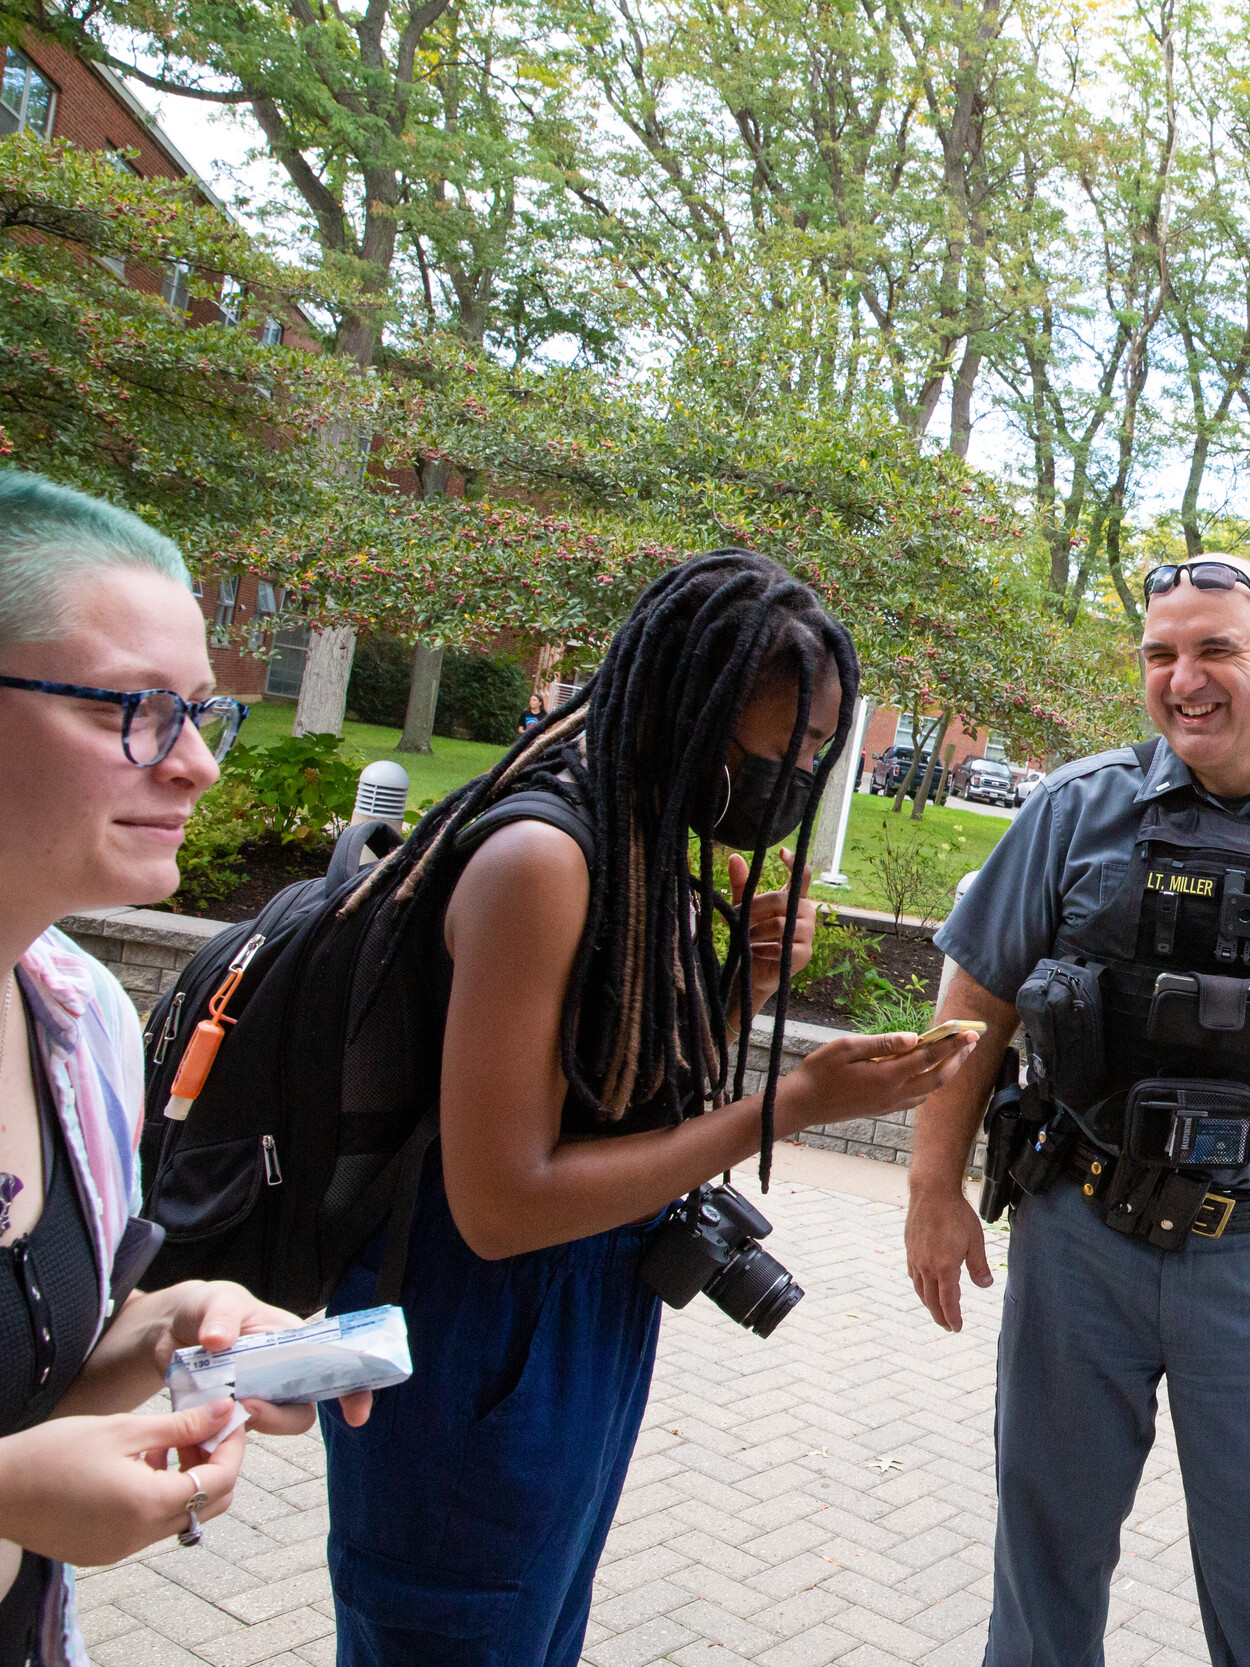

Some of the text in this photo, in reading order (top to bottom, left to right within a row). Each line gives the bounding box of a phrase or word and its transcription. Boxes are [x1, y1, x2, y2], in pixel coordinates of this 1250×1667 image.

[1147, 872, 1213, 896] LT. MILLER
[193, 1359, 210, 1369] 130
